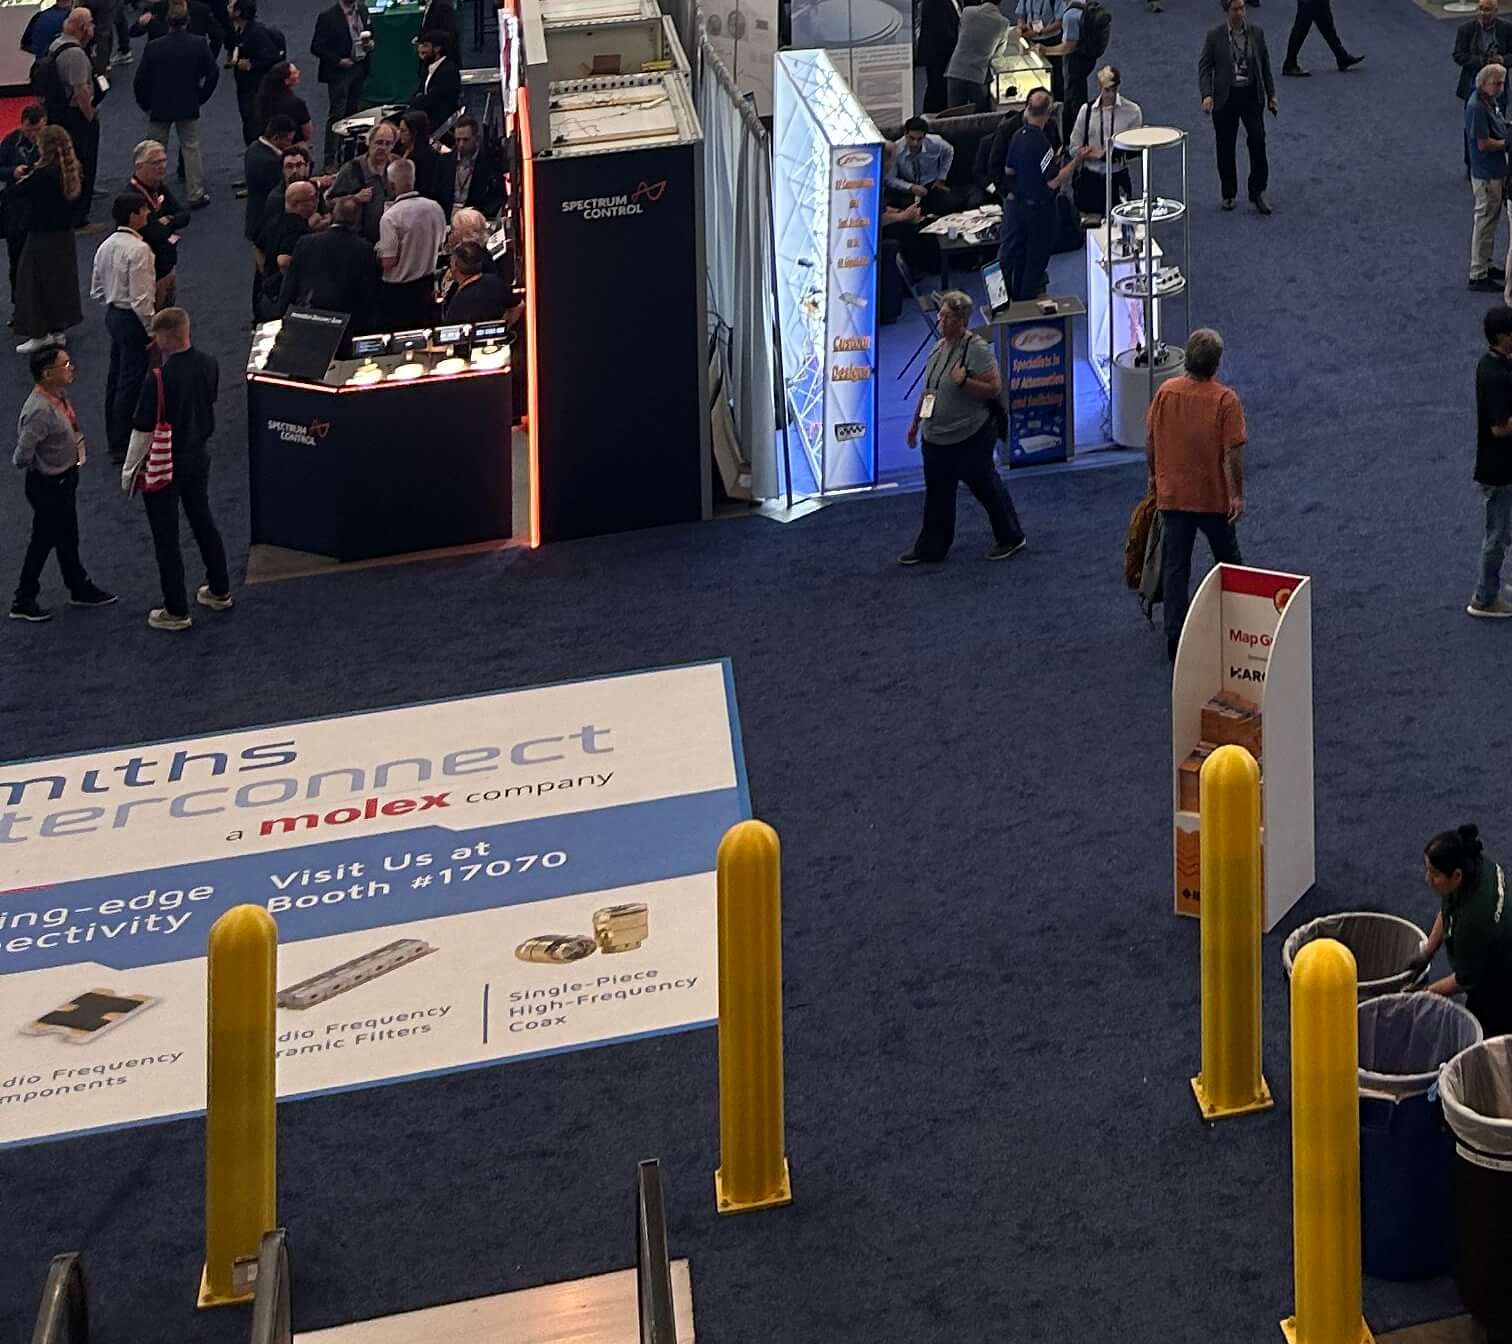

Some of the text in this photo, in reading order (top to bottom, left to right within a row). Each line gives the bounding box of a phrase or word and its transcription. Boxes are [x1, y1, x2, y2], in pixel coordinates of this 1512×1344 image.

[562, 195, 627, 212] SPECTRUM
[584, 203, 644, 219] CONTROL
[268, 419, 307, 435] SPECTRUM
[280, 430, 317, 447] CONTROL
[1229, 628, 1258, 649] Map
[0, 739, 297, 807] miths
[0, 724, 615, 845] terconnect
[225, 770, 615, 842] a molex company
[266, 850, 568, 914] Booth #17070
[269, 840, 492, 891] Visit Us at
[0, 911, 193, 954] ectivity
[508, 975, 699, 1018] High-Frequency
[509, 968, 659, 1003] Single-Piece
[276, 1023, 433, 1059] ramic Filters
[277, 1003, 451, 1044] dio Frequency
[509, 1015, 567, 1033] Coax
[2, 1050, 185, 1090] dio Frequency
[0, 1074, 128, 1106] mponents
